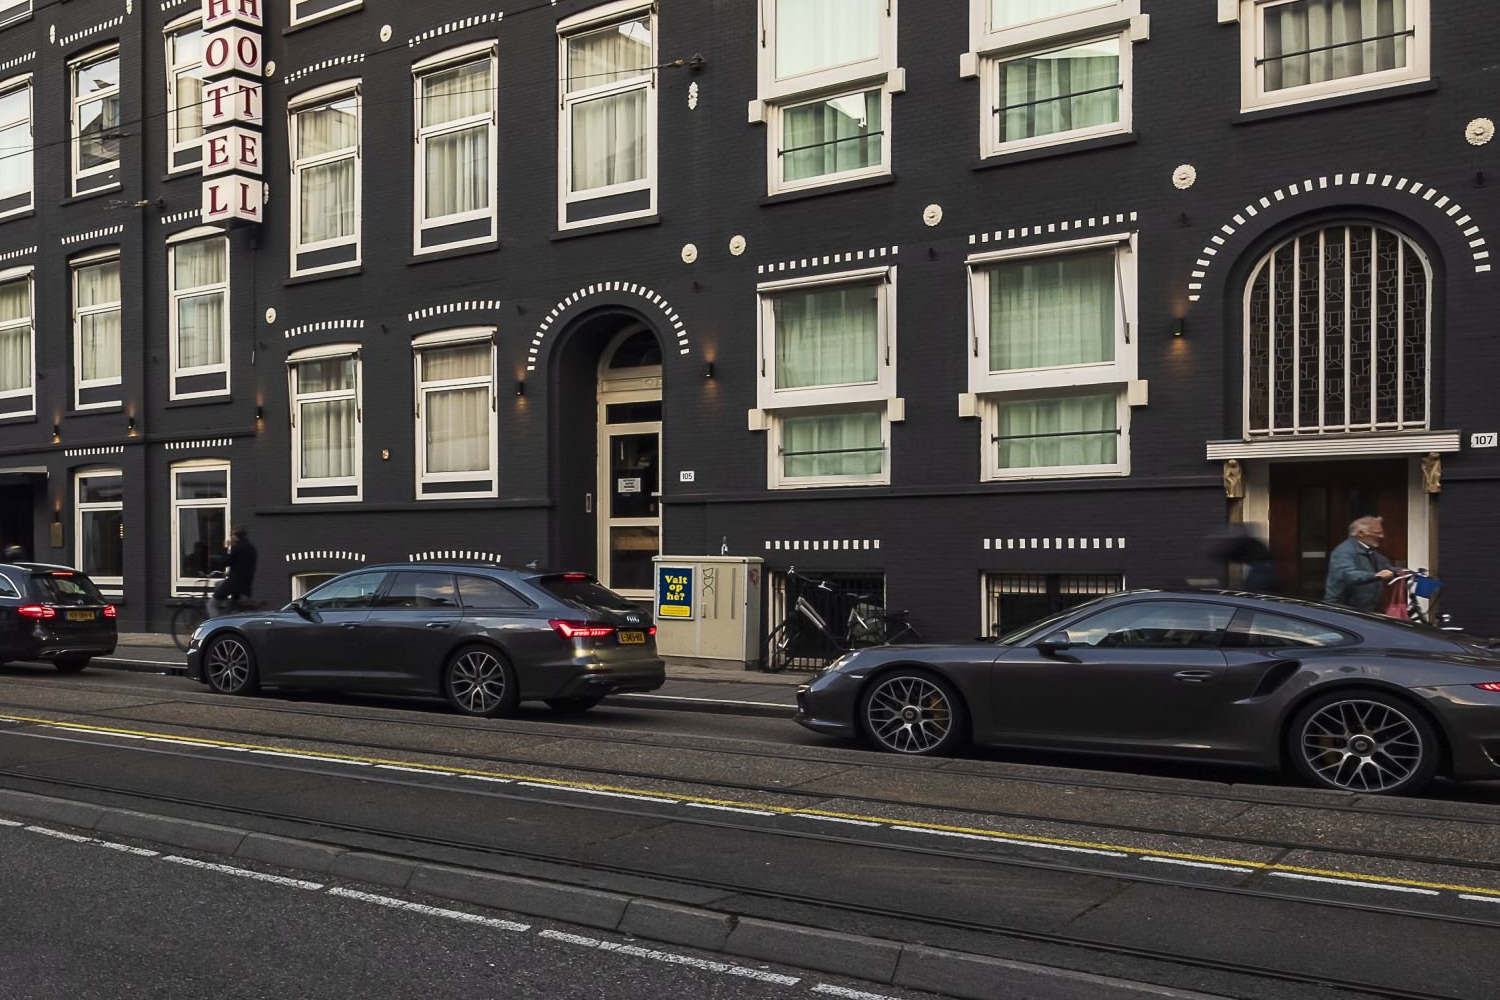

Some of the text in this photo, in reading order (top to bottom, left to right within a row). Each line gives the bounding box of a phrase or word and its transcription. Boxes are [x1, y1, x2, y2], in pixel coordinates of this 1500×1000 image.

[1474, 435, 1494, 445] 107
[682, 472, 693, 480] 105
[665, 575, 688, 584] Valt
[669, 584, 683, 592] op
